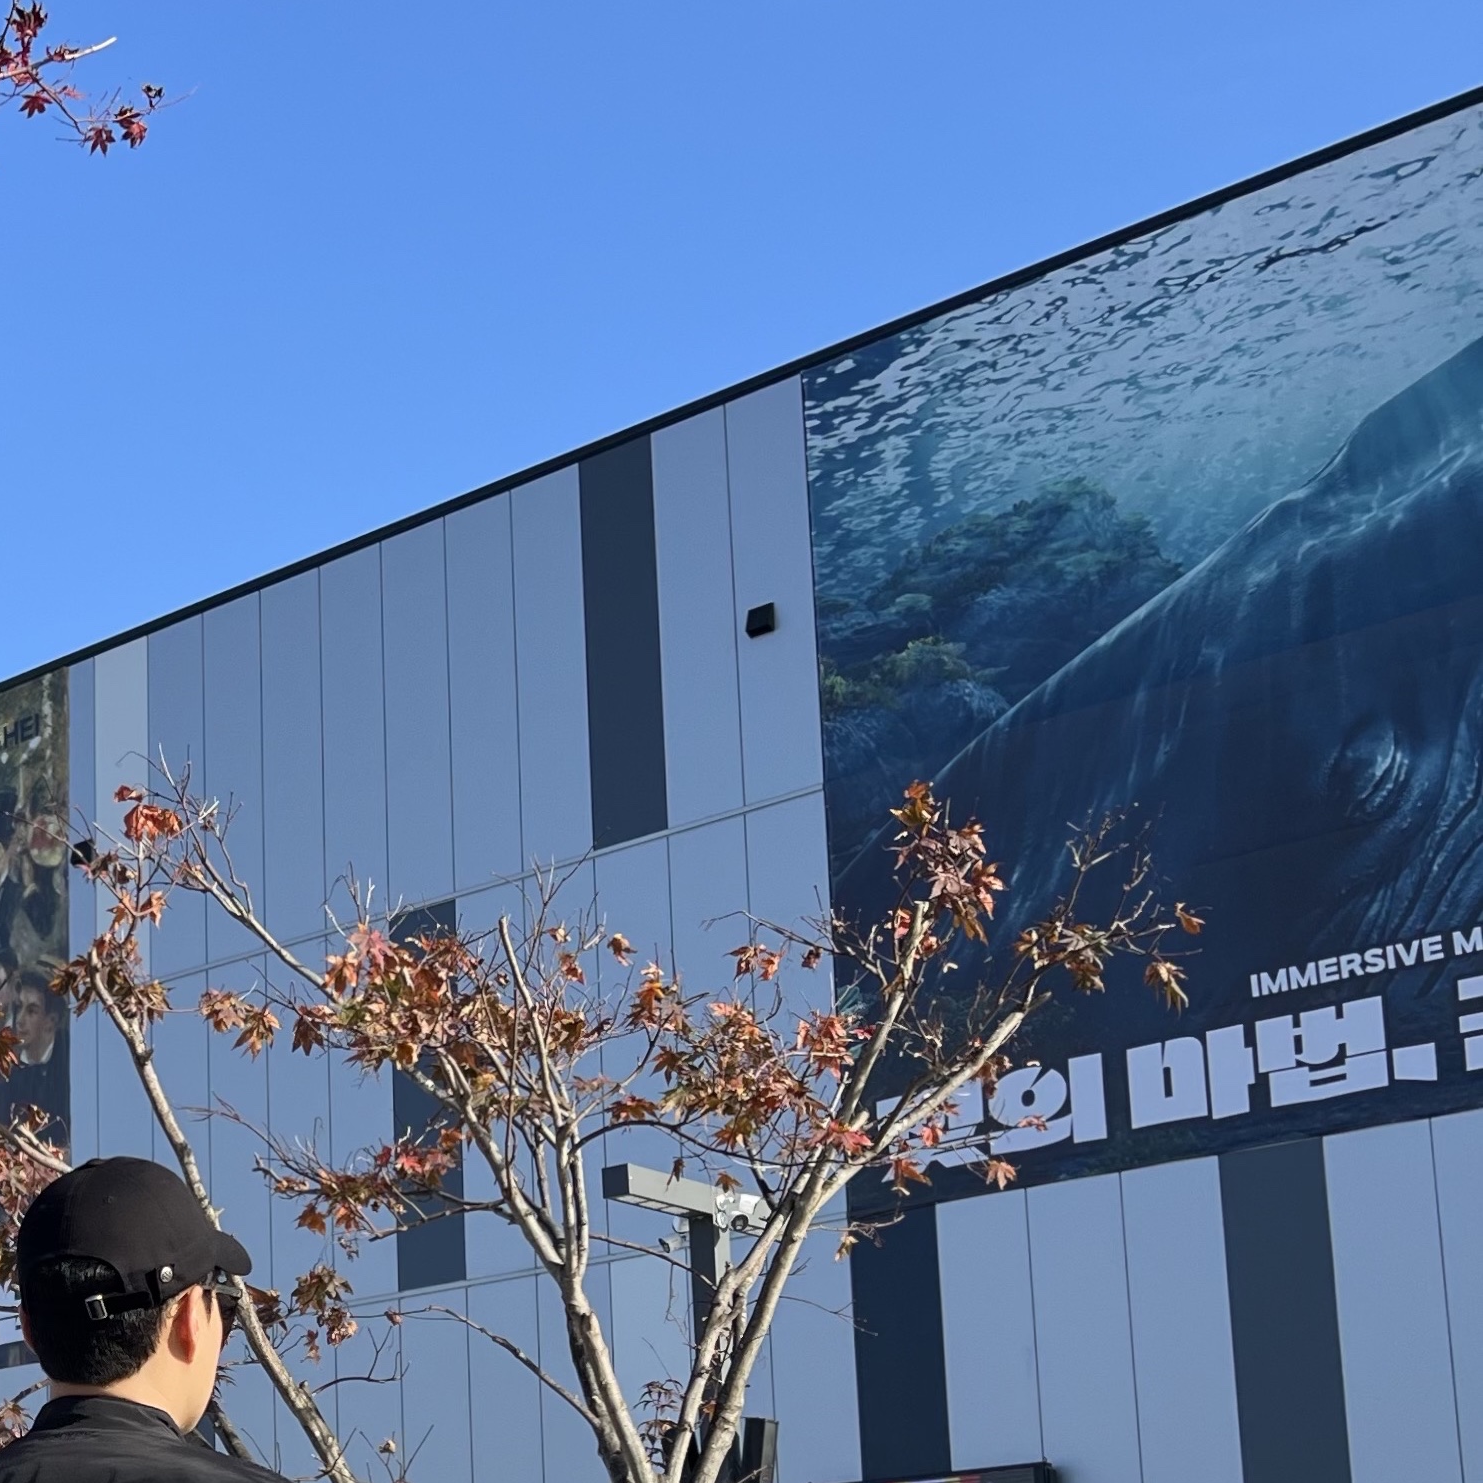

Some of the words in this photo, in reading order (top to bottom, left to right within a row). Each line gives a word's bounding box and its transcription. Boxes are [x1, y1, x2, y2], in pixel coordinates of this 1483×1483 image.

[3, 713, 39, 748] HEI
[1250, 935, 1445, 998] IMMERSIVE
[1126, 995, 1438, 1129] 마법.
